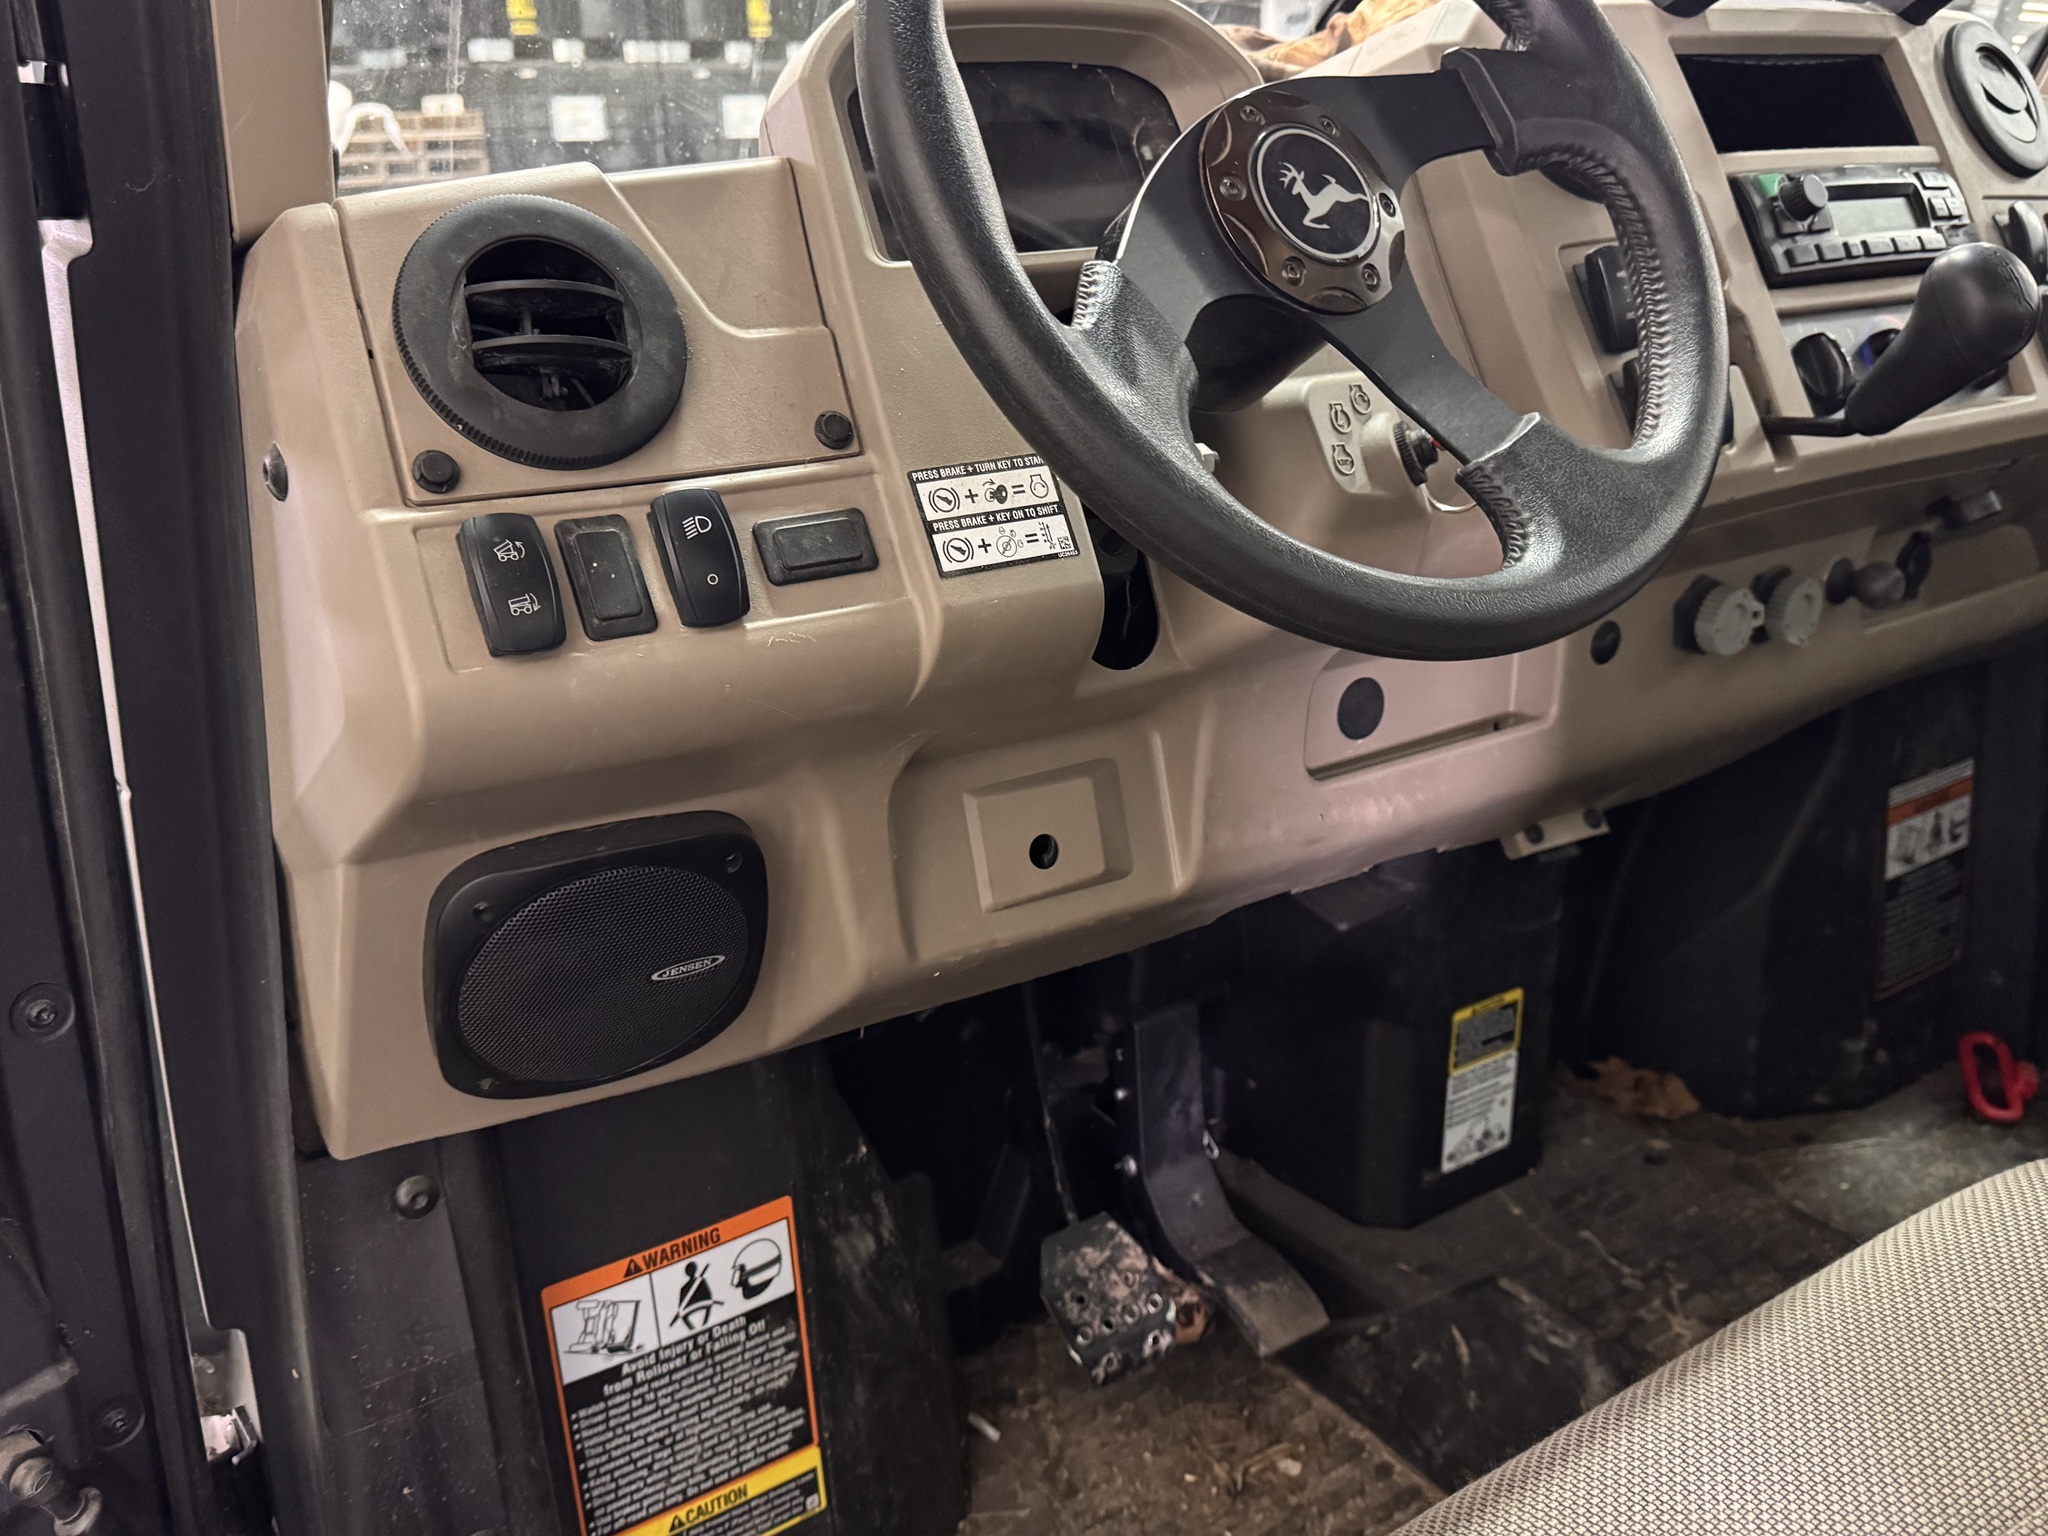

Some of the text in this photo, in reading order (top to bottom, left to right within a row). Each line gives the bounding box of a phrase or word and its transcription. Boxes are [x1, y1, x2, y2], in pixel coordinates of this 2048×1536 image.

[912, 469, 939, 482] PRESS
[940, 465, 966, 478] BRAKE
[974, 460, 997, 472] TURN
[997, 460, 1012, 470] KEY
[1012, 458, 1024, 467] TO
[933, 518, 960, 532] PRESS
[960, 515, 987, 528] BRAKE
[996, 512, 1012, 522] KEY
[1013, 510, 1024, 520] ON
[1025, 508, 1036, 518] TO
[1037, 504, 1059, 516] SHIFT
[662, 958, 712, 978] JENSEN
[642, 1227, 720, 1270] WARNING
[602, 1318, 765, 1396] from Rollover or Falling Off
[620, 1314, 746, 1376] Avoid Injury or Death
[686, 1483, 748, 1523] CAUTION
